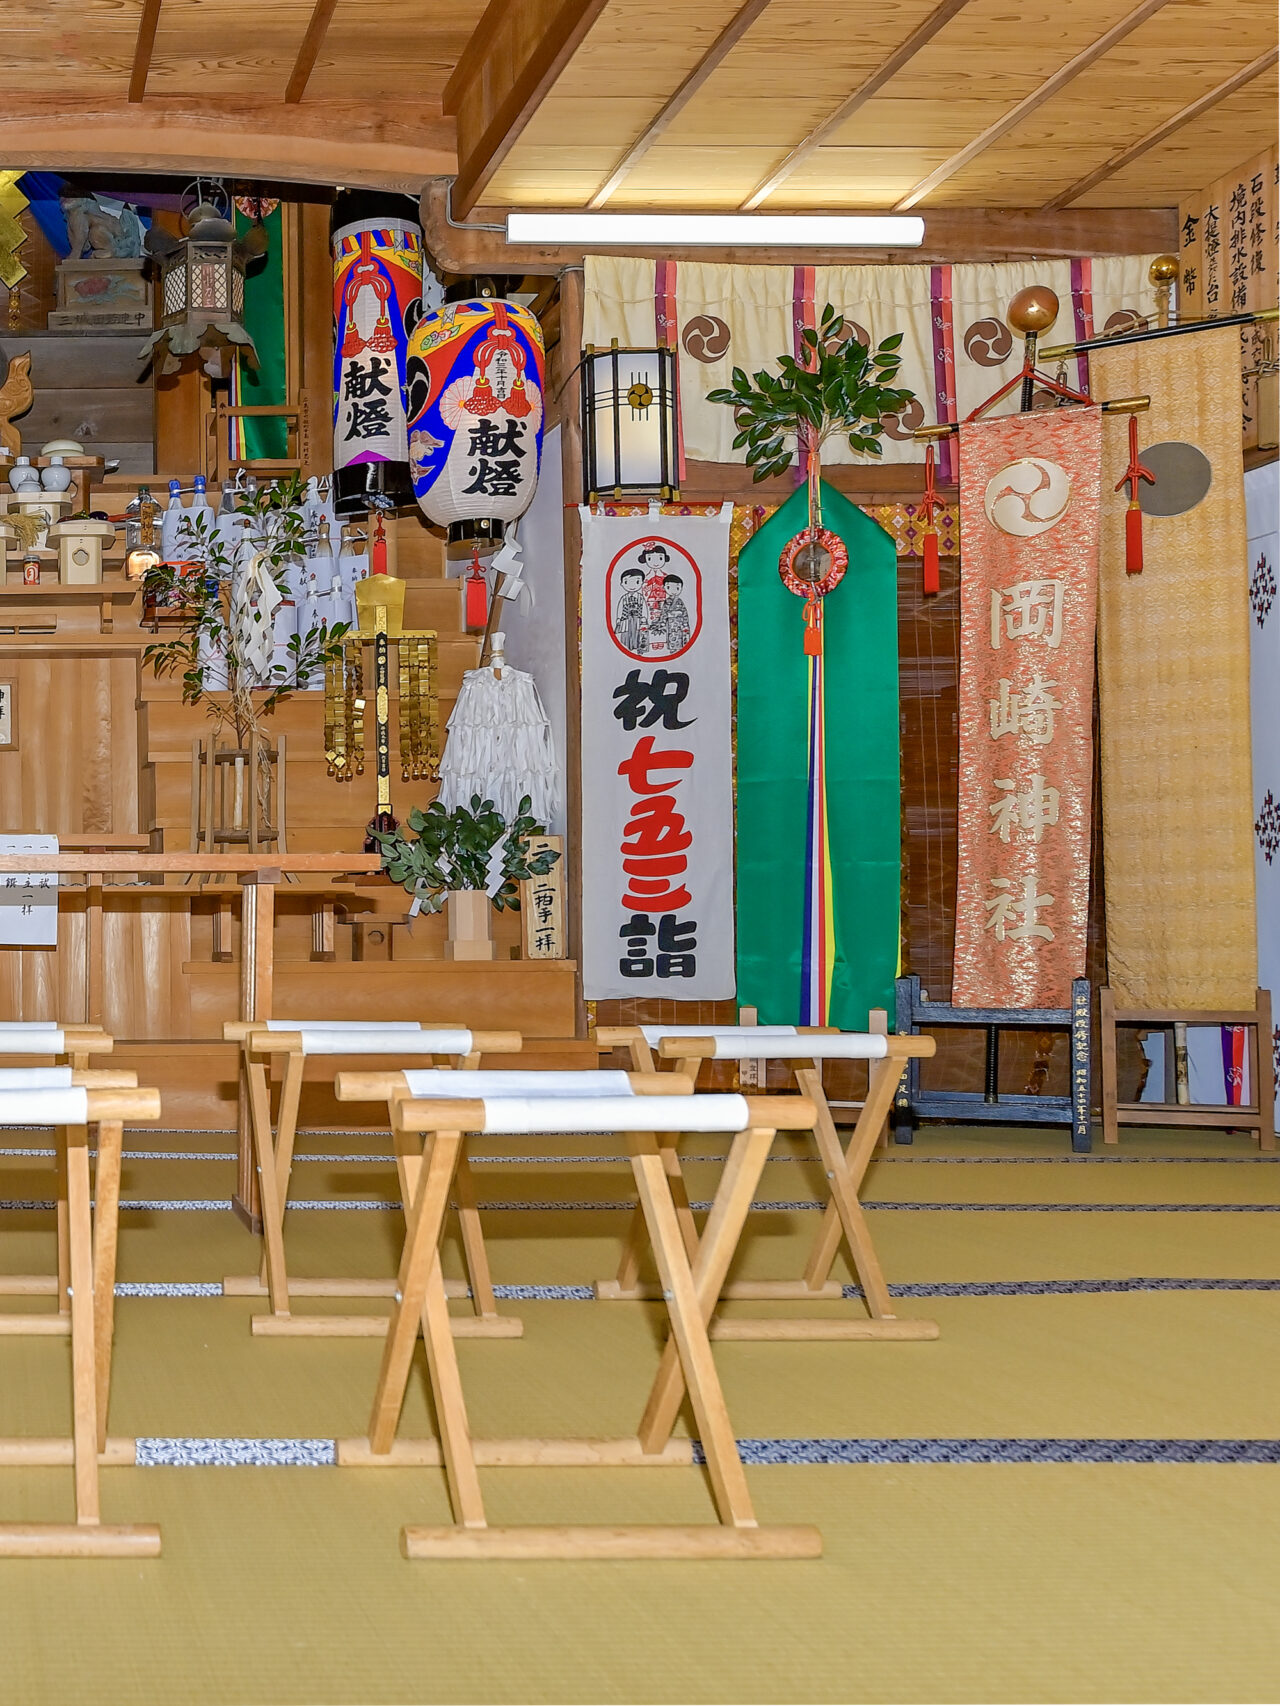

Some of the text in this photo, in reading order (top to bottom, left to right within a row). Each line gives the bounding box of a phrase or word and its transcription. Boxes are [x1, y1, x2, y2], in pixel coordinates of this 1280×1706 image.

[612, 668, 698, 980] 祝七五三詣
[984, 578, 1065, 943] 岡崎神社
